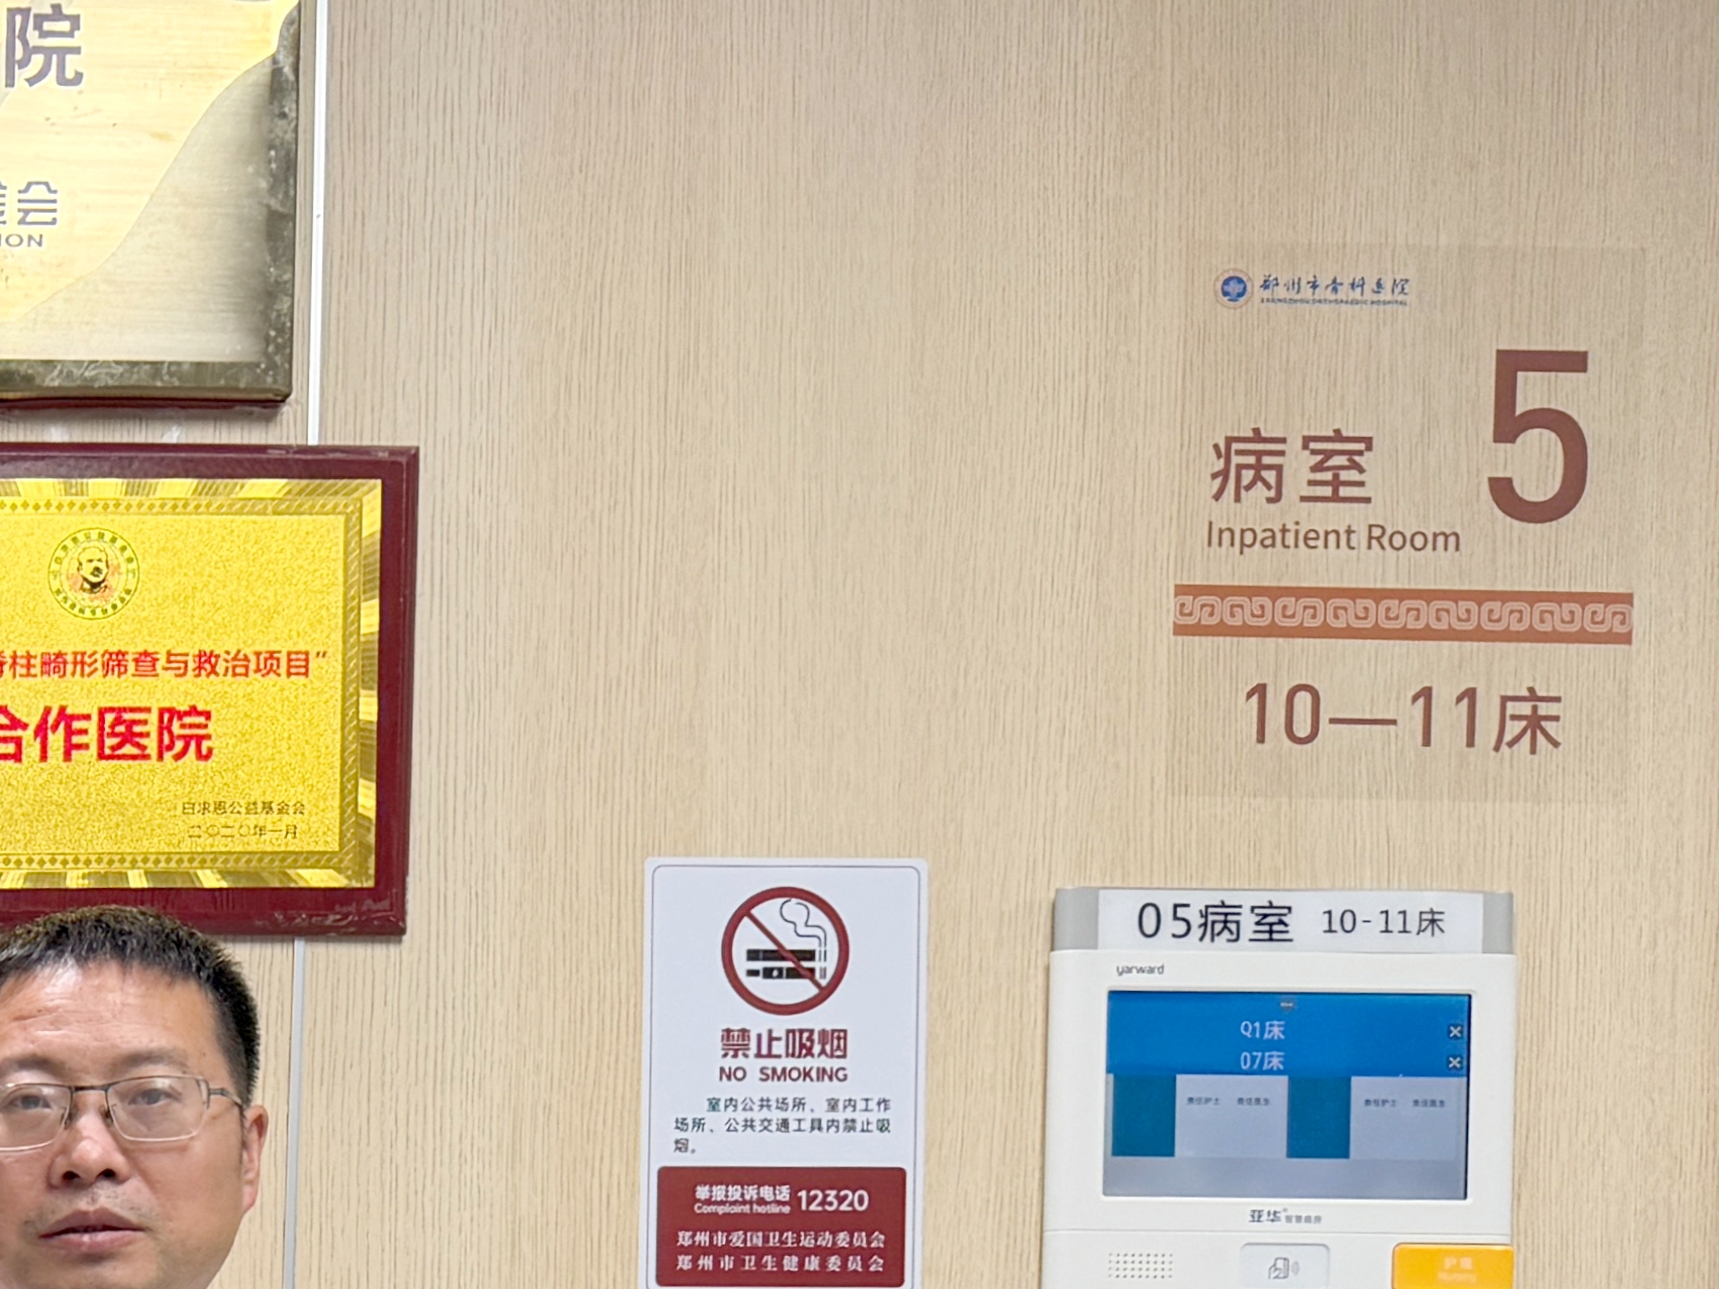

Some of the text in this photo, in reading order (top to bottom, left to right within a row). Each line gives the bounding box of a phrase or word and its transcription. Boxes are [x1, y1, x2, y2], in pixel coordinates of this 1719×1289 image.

[1487, 349, 1589, 524] 5
[1210, 427, 1374, 504] 病室
[1206, 521, 1461, 555] Inpatient Room
[1136, 900, 1446, 943] 05病室 10-11床
[1116, 963, 1165, 977] yarward
[720, 1028, 848, 1059] 禁止吸烟
[719, 1066, 848, 1083] NO SMOKING
[706, 1096, 892, 1113] 室内公共场所、室内工作
[674, 1117, 892, 1133] 场所、公共交通工具内禁止吸
[695, 1184, 791, 1202] 举报投诉电话
[797, 1189, 870, 1212] 12320
[694, 1202, 791, 1215] Complaint hotline
[1248, 1209, 1281, 1223] 亚华
[676, 1230, 886, 1248] 郑州市爱国卫生运动委员会
[676, 1255, 885, 1272] 郑州市卫生健康委员会
